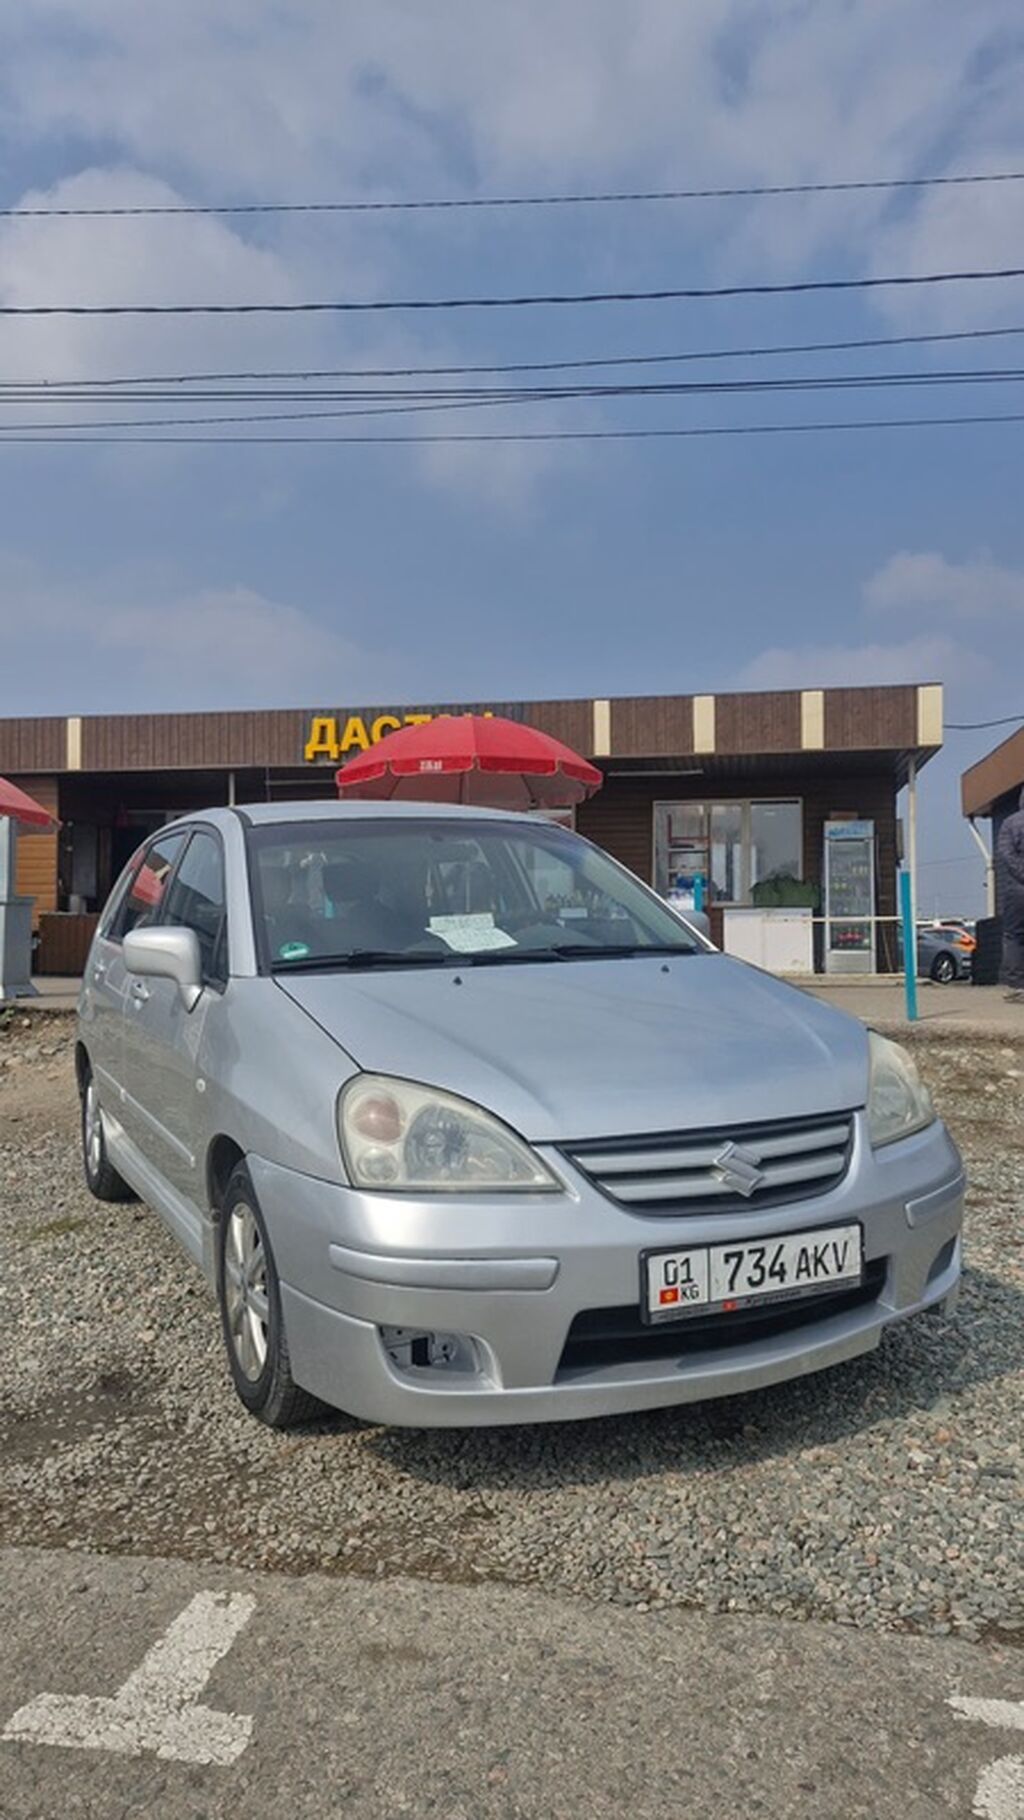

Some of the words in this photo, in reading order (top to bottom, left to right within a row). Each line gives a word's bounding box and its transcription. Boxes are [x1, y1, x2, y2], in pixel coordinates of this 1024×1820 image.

[663, 1258, 695, 1286] 01
[723, 1243, 788, 1292] 734
[795, 1240, 849, 1280] AKV
[680, 1283, 700, 1300] KG
